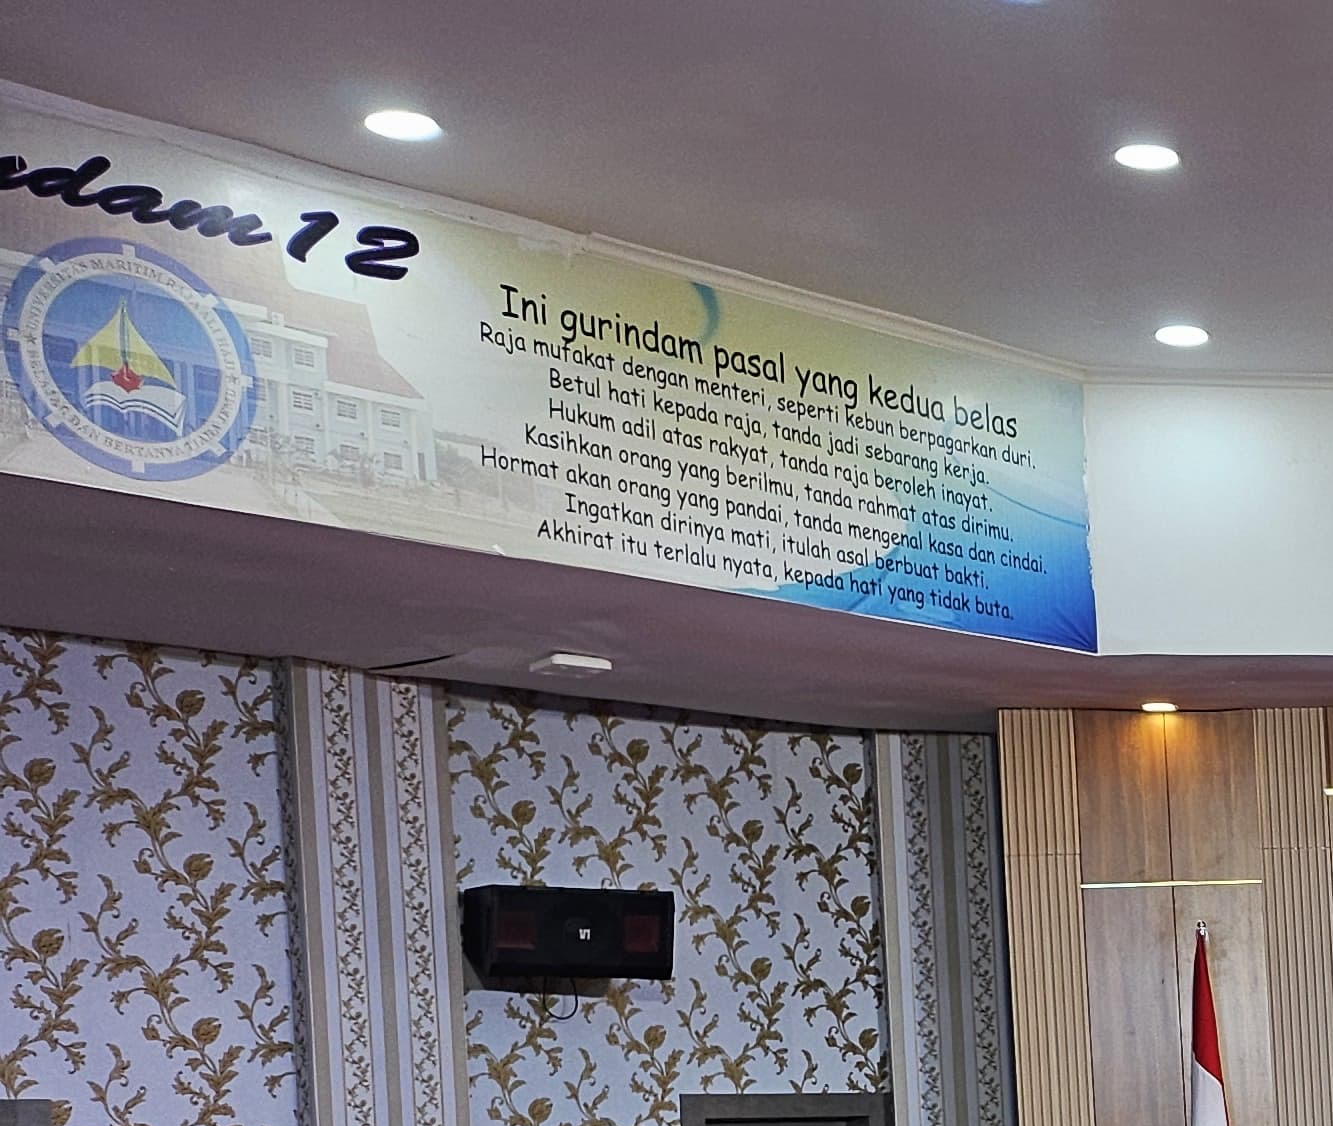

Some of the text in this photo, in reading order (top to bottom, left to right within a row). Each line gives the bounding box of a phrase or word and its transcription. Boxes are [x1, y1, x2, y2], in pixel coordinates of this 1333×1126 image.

[286, 210, 420, 280] 12
[479, 320, 1037, 471] Raja mufakat dengan menteri, seperti kebun berpagarkan duri.
[499, 283, 1018, 439] Ini gurindam pasal yang kedua belas
[525, 422, 1014, 543] Kasihkan orang yang berilmu, tanda rahmat atas dirimu.
[548, 397, 993, 513] Hukum adil atas rakyat, tanda raja beroleh inayat.
[549, 367, 991, 489] Betul hati kepada raja, tanda jadi sebarang kerja.
[480, 444, 1047, 575] Hormat akan orang yang pandai, tanda mengenal kasa dan cindai.
[537, 518, 1014, 621] Akhirat itu terlalu nyata, kepada hati yang tidak buta.
[564, 492, 989, 590] Ingatkan dirinya mati, itulah asal berbuat bakti.
